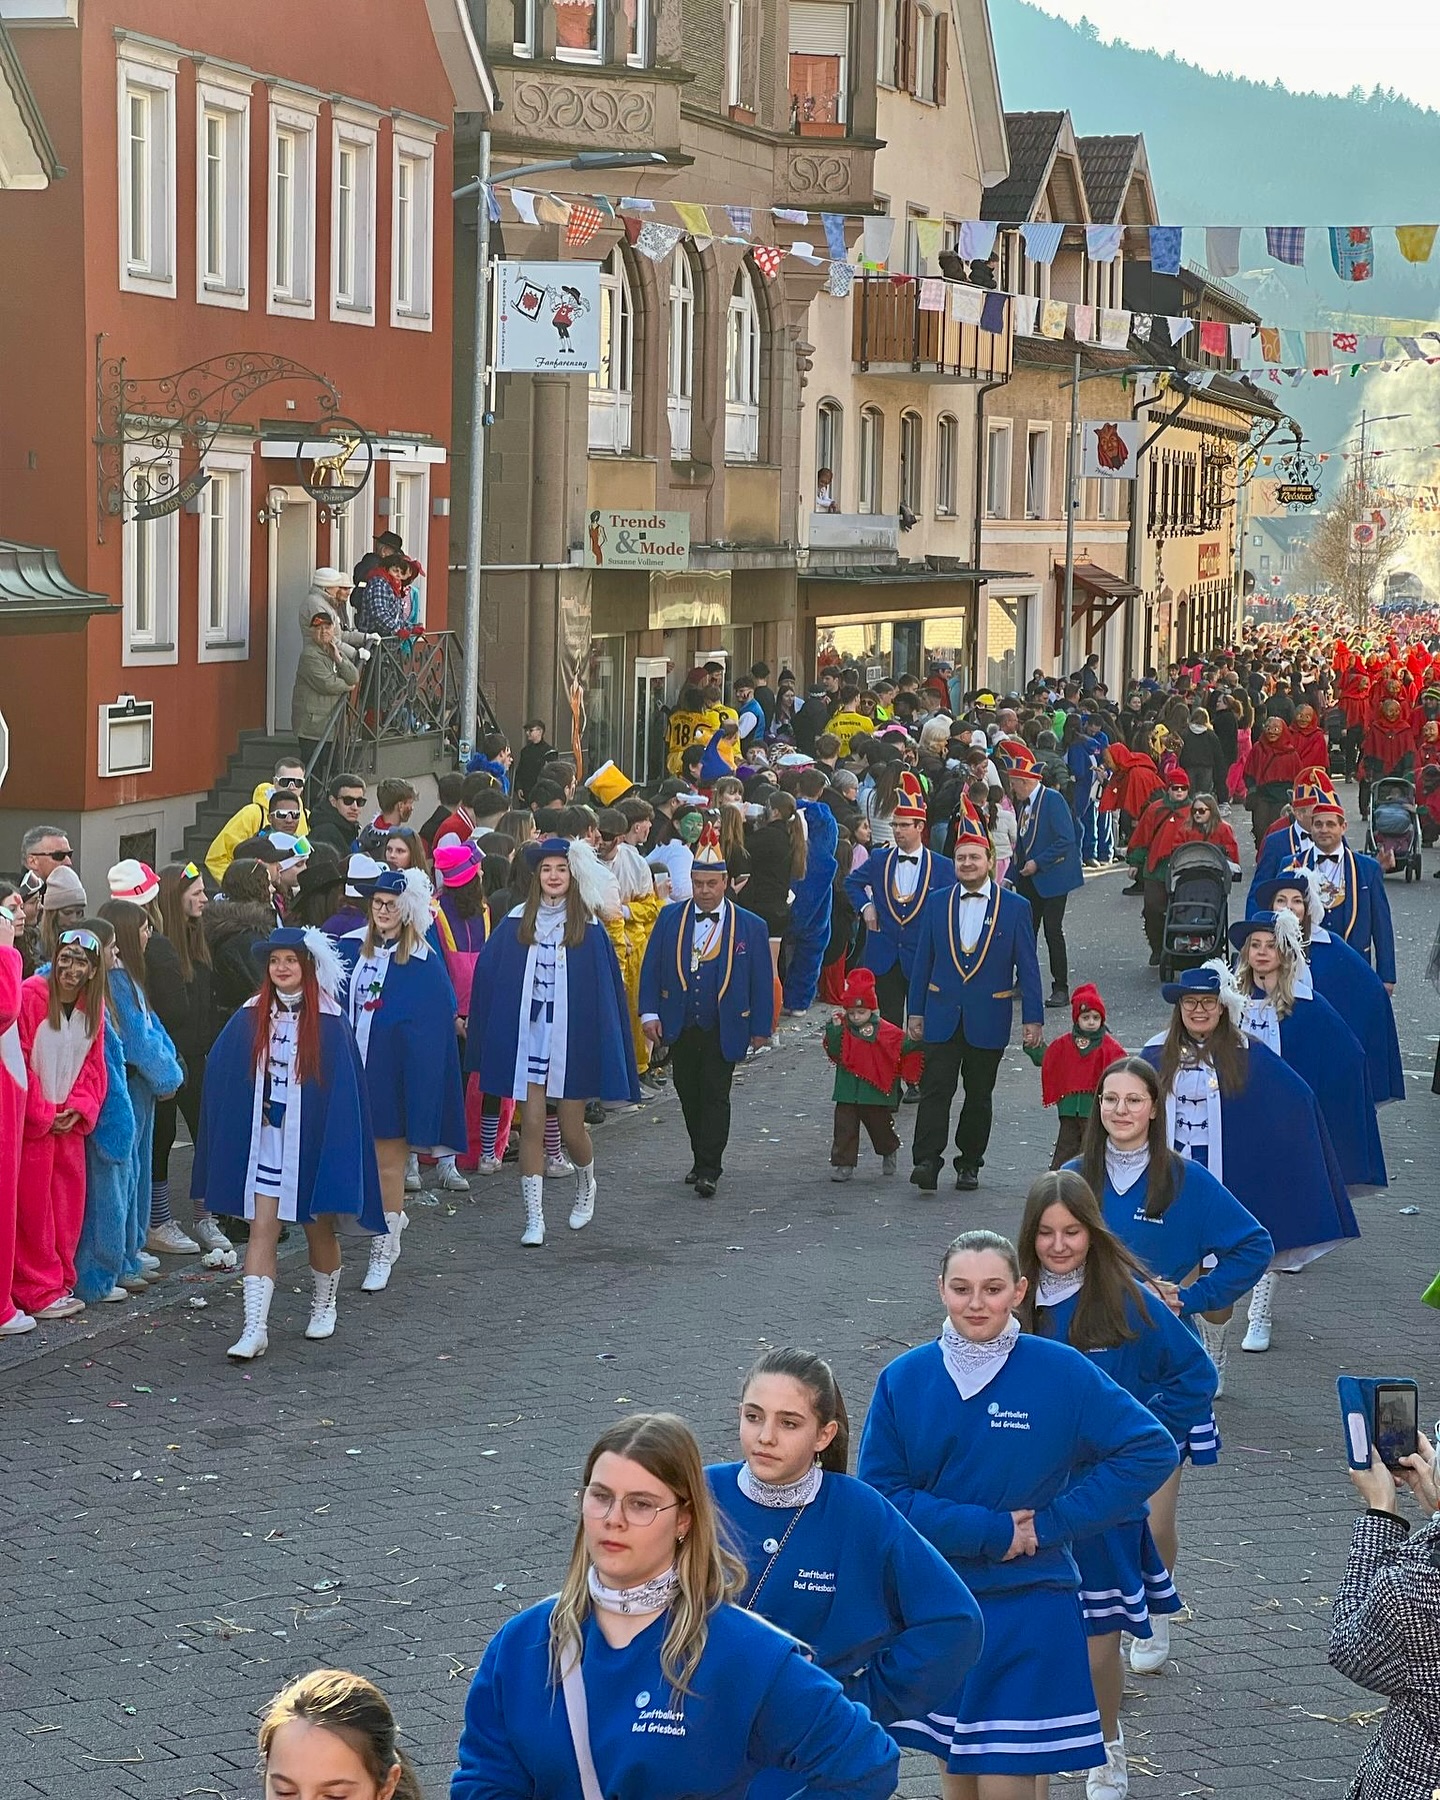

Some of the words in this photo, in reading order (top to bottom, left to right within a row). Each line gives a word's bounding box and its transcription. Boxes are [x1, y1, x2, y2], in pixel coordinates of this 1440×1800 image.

[534, 357, 588, 369] Fanfarenzug
[149, 496, 182, 517] ULMER
[181, 482, 199, 501] BIER
[1280, 492, 1315, 502] Rebstock
[609, 515, 666, 529] Trends
[615, 530, 639, 555] &
[640, 542, 685, 555] Mode
[608, 558, 636, 566] Susanne
[637, 557, 664, 566] Vollmer
[674, 722, 691, 747] 18
[990, 1420, 1002, 1428] Bad
[1002, 1420, 1031, 1430] Griesbach
[798, 1568, 835, 1580] Zunftballett
[793, 1580, 807, 1590] Bad
[807, 1582, 836, 1593] Griesbach
[631, 1722, 647, 1732] Bad
[647, 1722, 686, 1736] Griesbach
